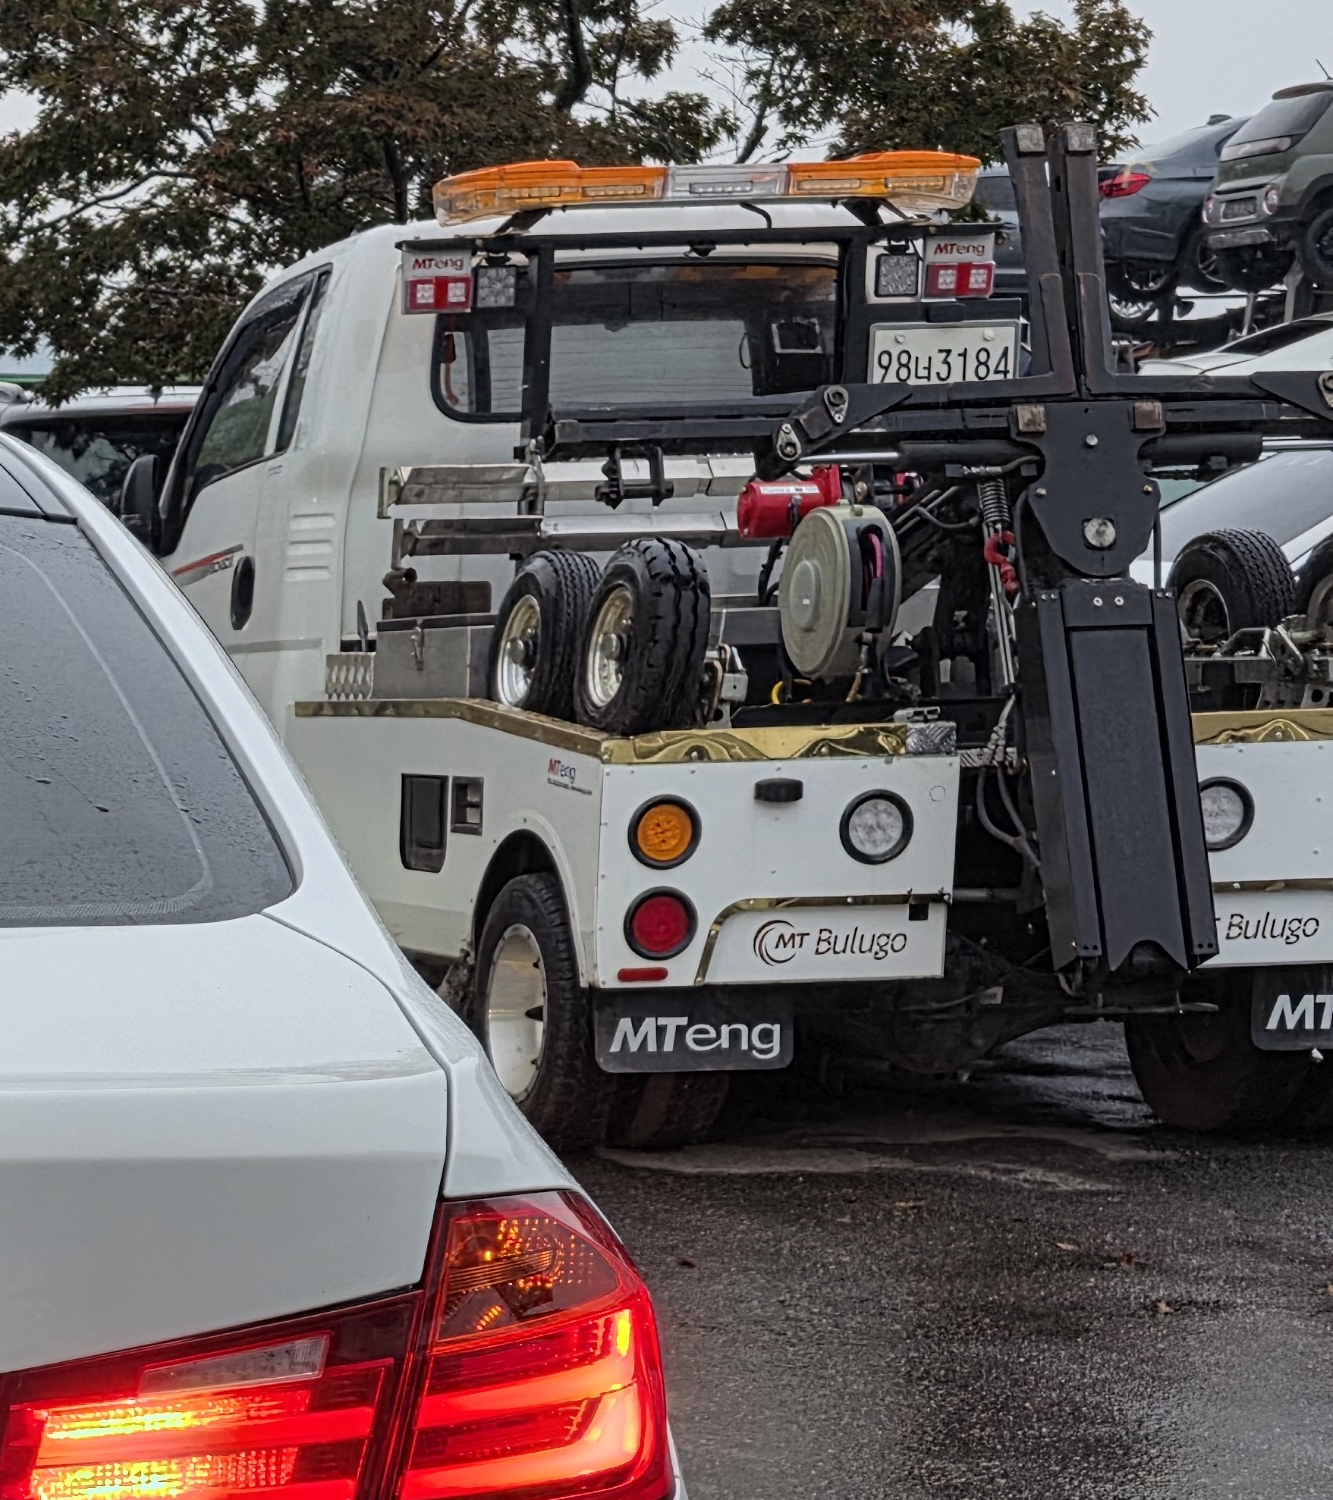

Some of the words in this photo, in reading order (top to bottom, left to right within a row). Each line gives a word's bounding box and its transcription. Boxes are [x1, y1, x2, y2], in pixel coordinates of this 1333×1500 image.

[933, 243, 985, 257] MTeng
[877, 346, 1010, 383] 98너3184
[774, 932, 811, 950] MT
[814, 926, 908, 960] Bulugo
[1225, 911, 1320, 945] Bulugo
[609, 1016, 781, 1060] MTeng
